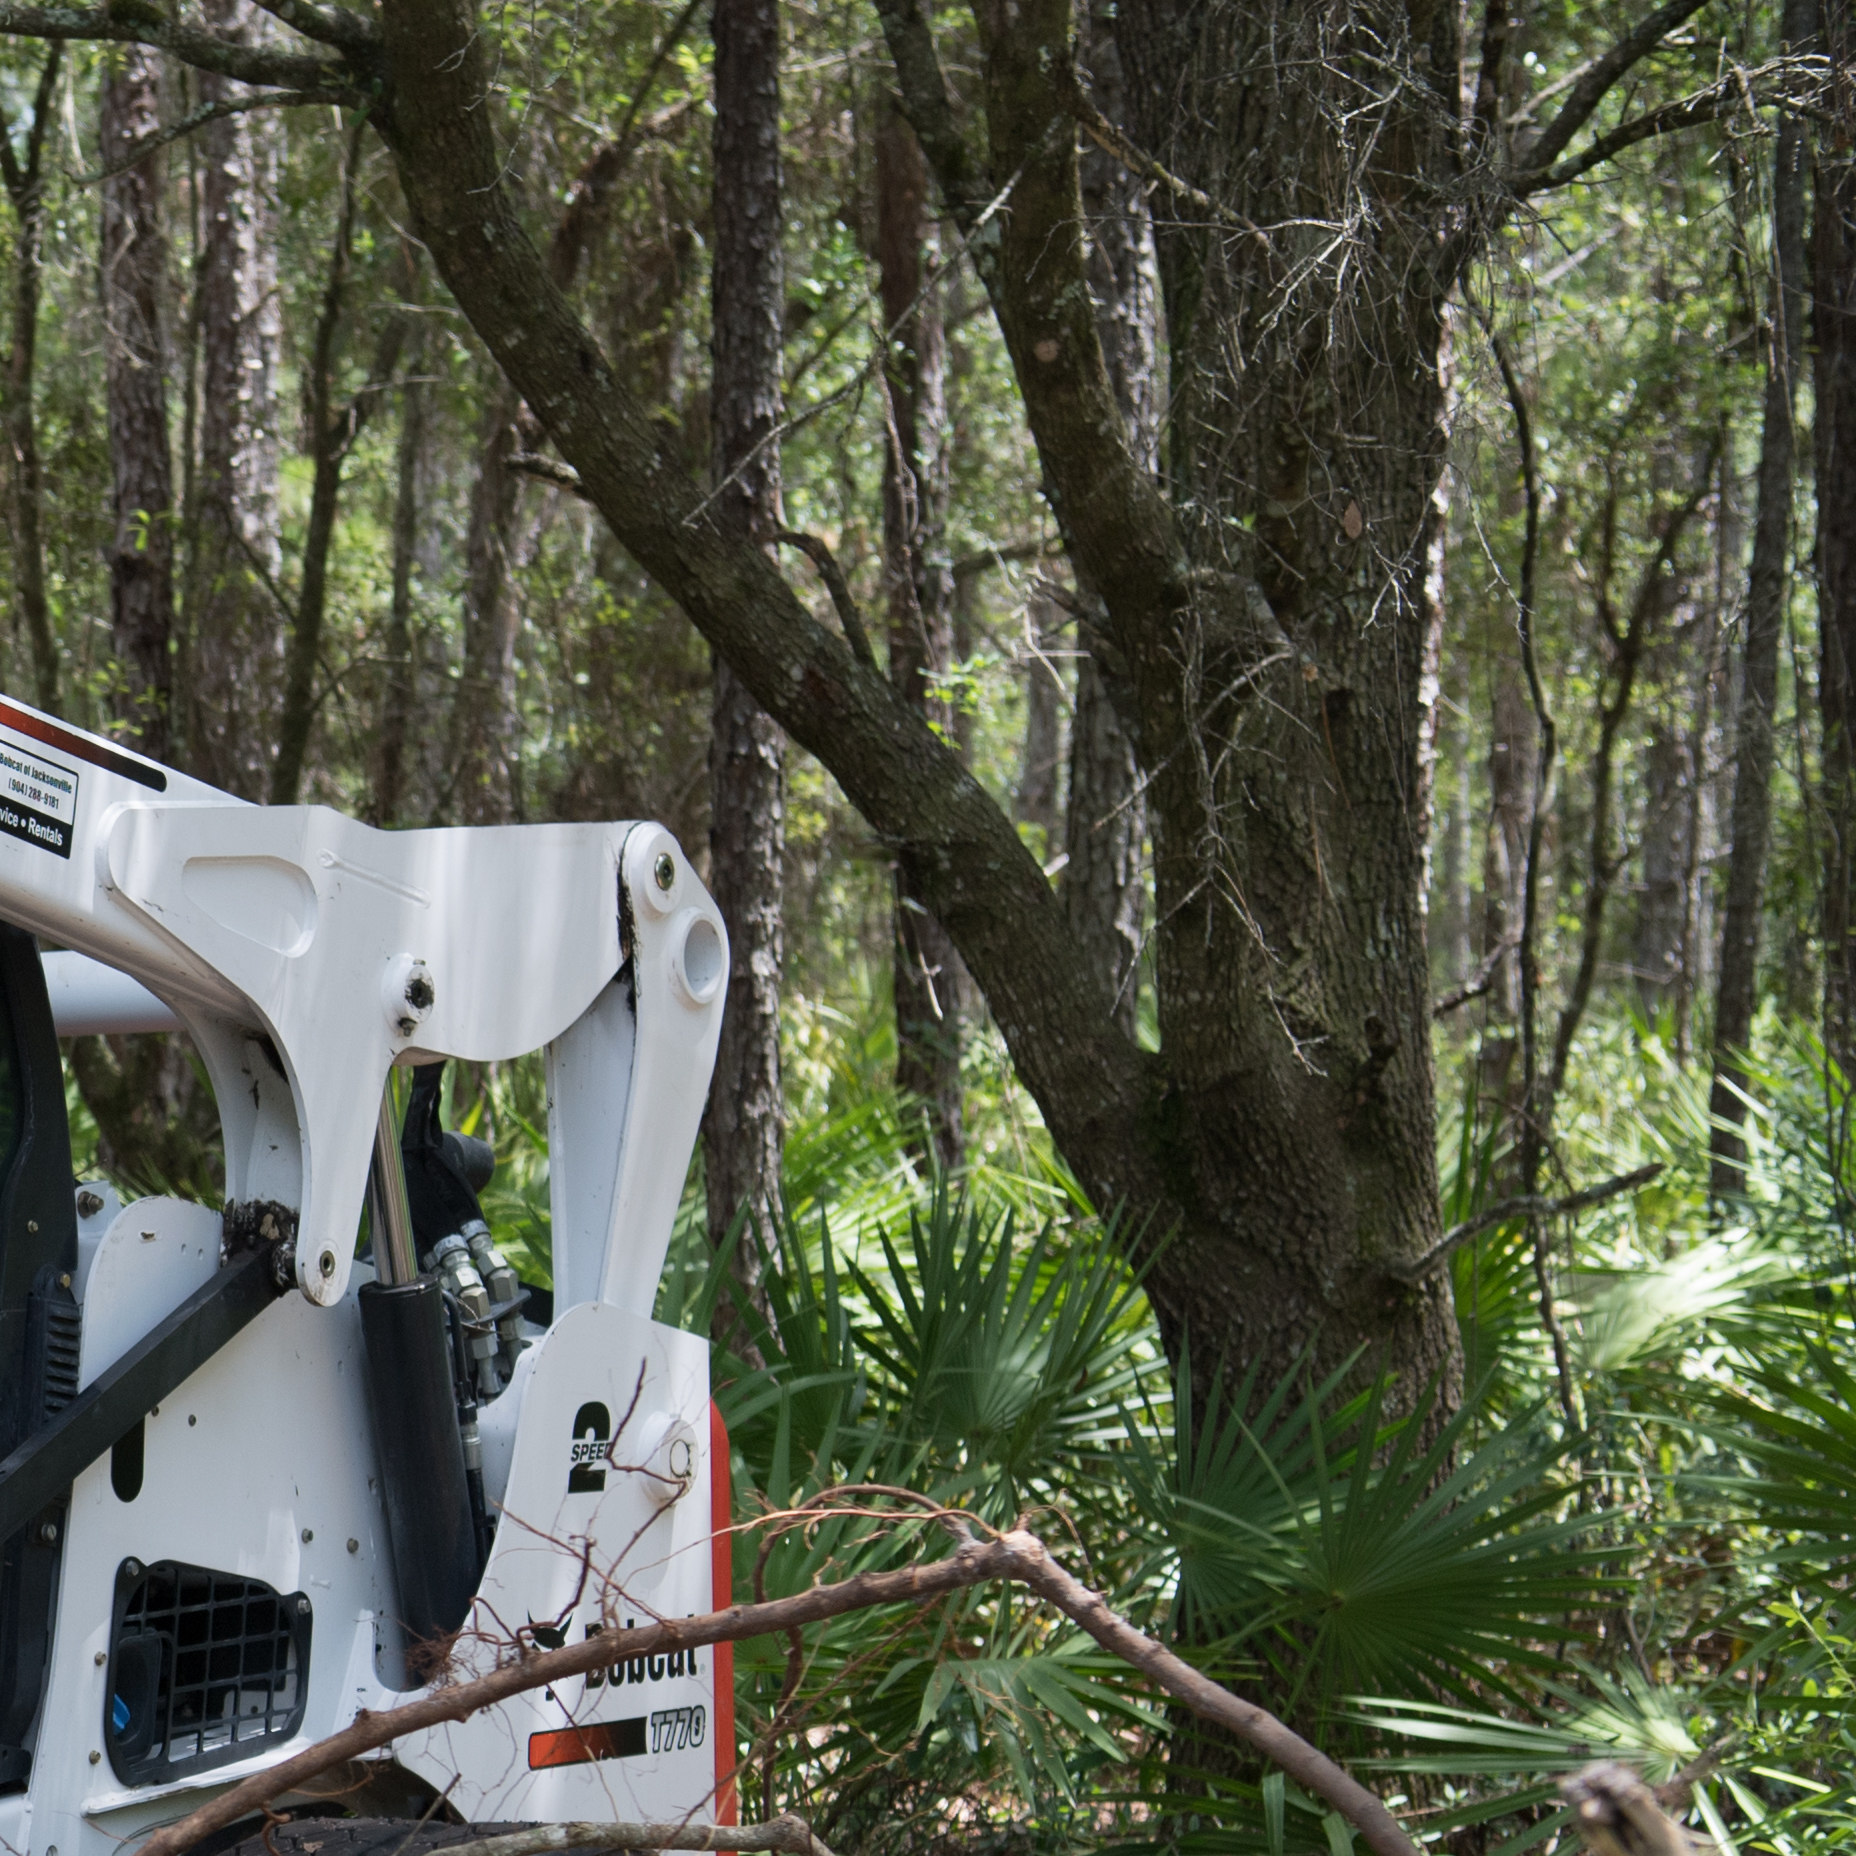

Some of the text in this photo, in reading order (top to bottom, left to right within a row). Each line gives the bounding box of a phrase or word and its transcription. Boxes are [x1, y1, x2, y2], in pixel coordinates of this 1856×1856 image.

[0, 753, 72, 794] Bobcat of Jacksonville
[8, 777, 28, 796] (904)
[28, 817, 63, 846] Rentals
[651, 1705, 706, 1754] T770
